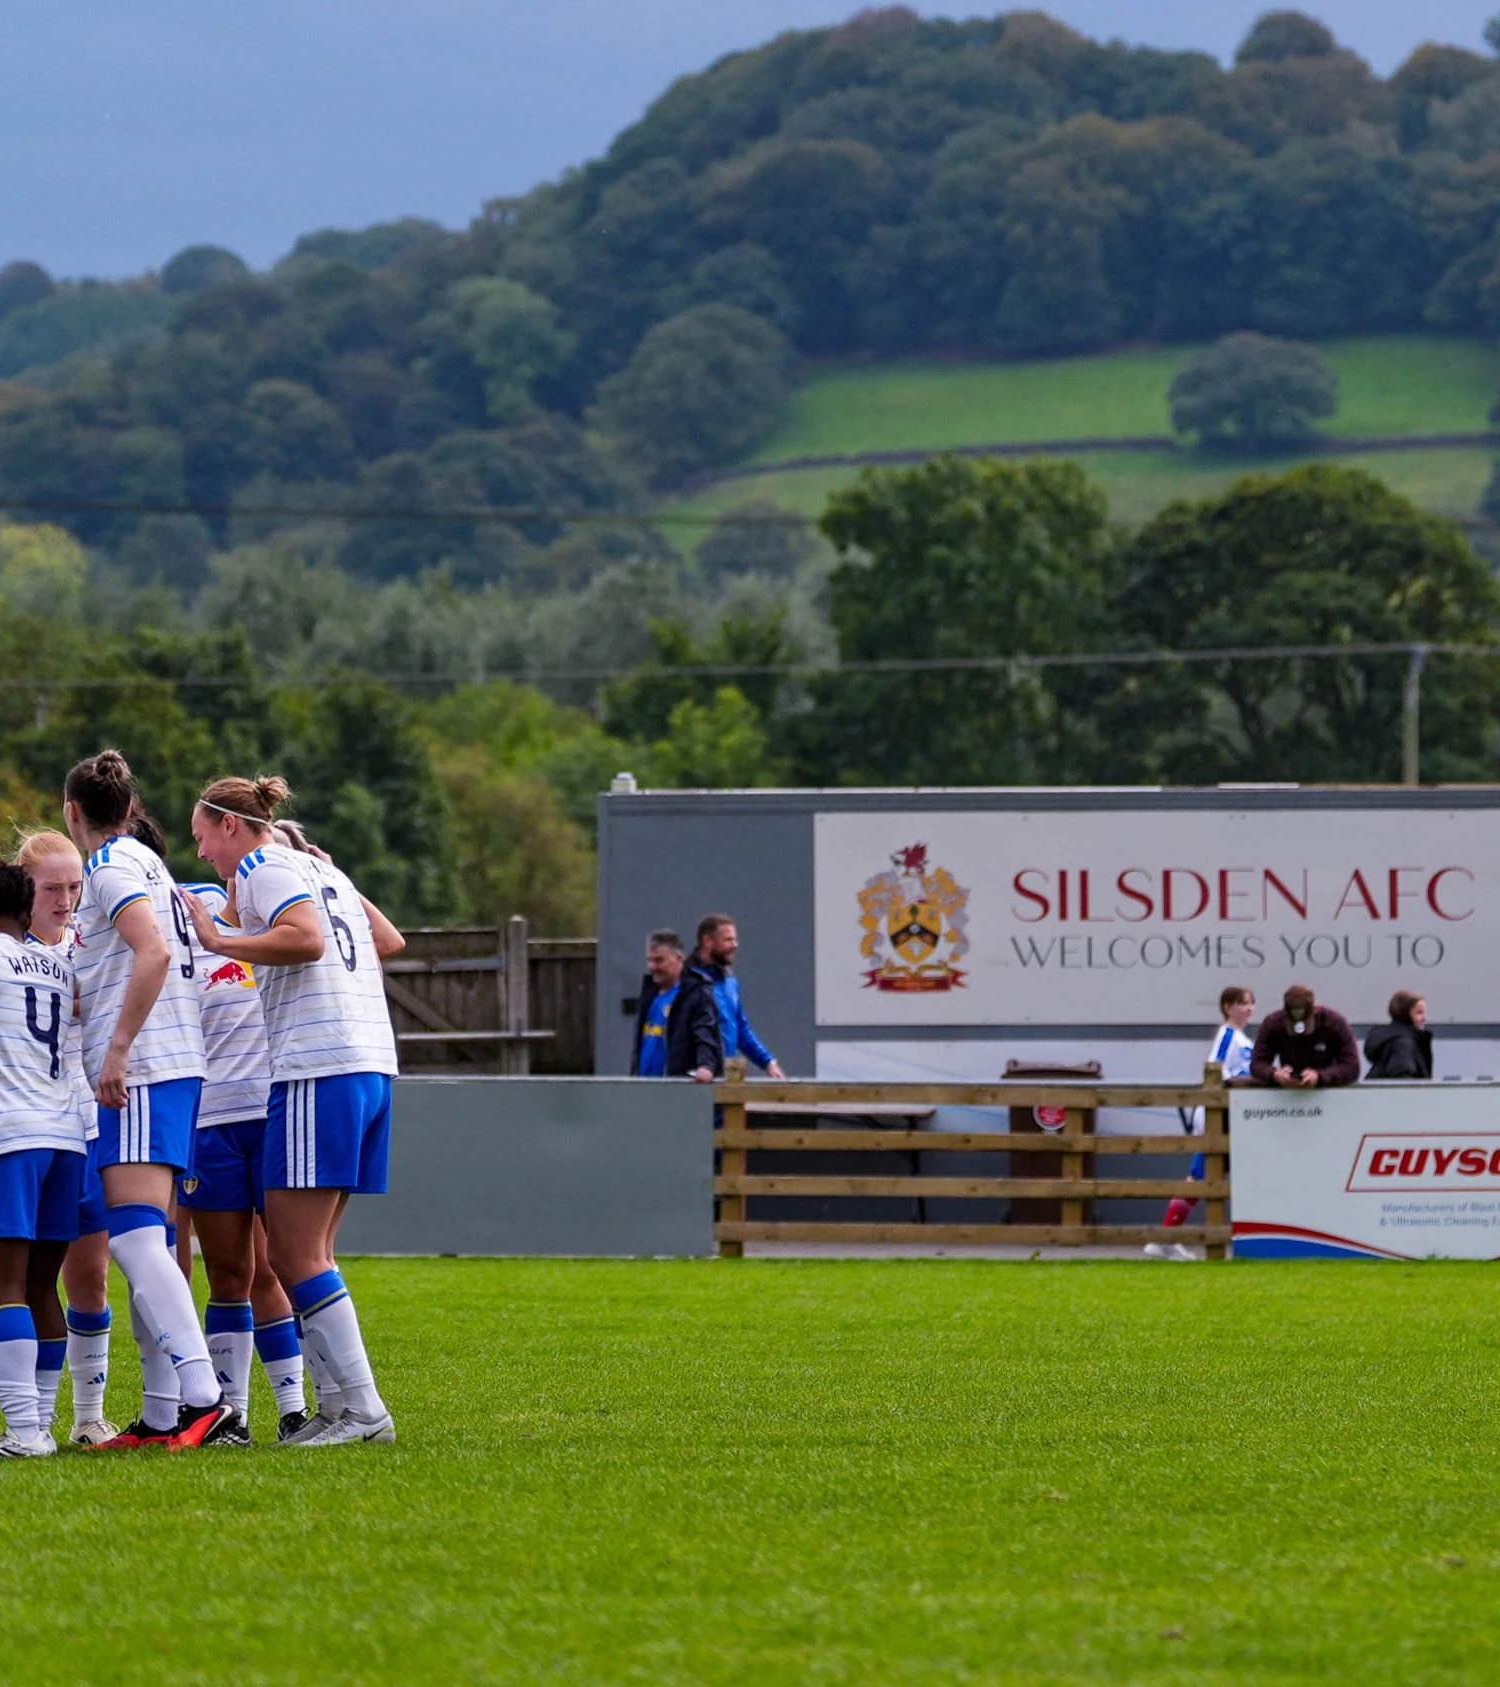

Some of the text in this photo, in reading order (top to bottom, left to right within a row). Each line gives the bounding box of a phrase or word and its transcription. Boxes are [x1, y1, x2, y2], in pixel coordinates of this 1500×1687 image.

[1012, 866, 1475, 922] SILSDEN AFC
[170, 887, 194, 979] 9
[321, 887, 356, 972] 6
[1011, 934, 1445, 968] WELCOMES YOU TO
[9, 956, 68, 987] WATSON
[25, 986, 60, 1079] 4
